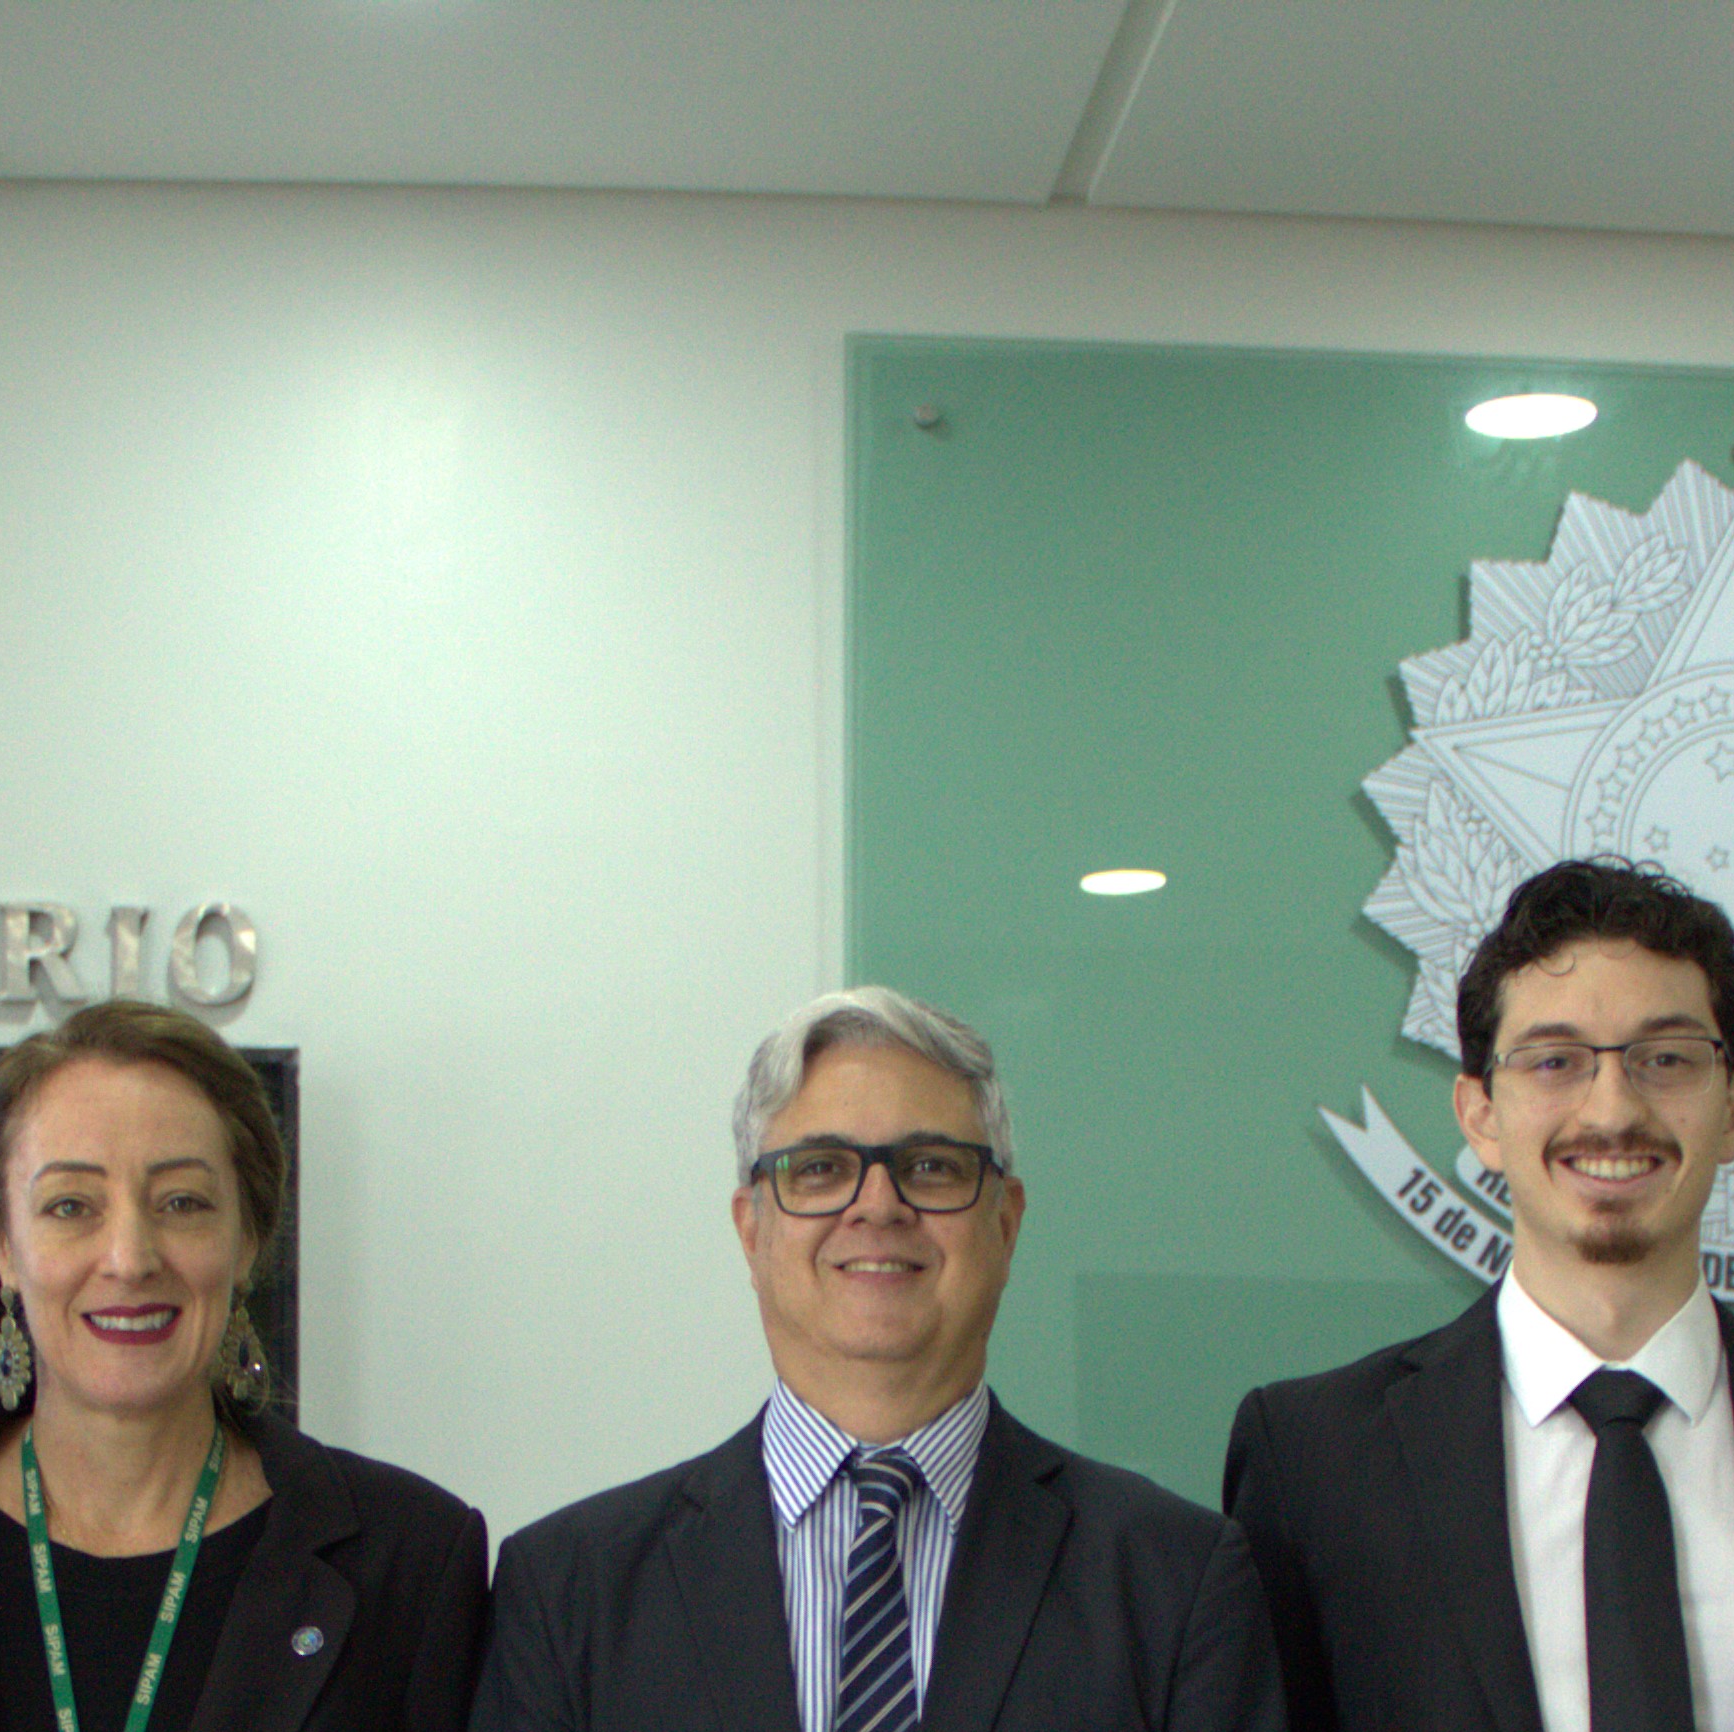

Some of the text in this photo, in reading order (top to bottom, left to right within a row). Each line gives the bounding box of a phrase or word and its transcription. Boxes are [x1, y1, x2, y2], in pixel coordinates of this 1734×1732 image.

[1397, 1167, 1477, 1253] 15 de
[25, 1467, 41, 1515] SIPAM
[185, 1497, 209, 1543] SIPAM
[33, 1542, 52, 1593] SIPAM
[159, 1571, 187, 1623] SIPAM
[45, 1623, 66, 1676] SIPAM
[136, 1652, 162, 1706] SIPAM
